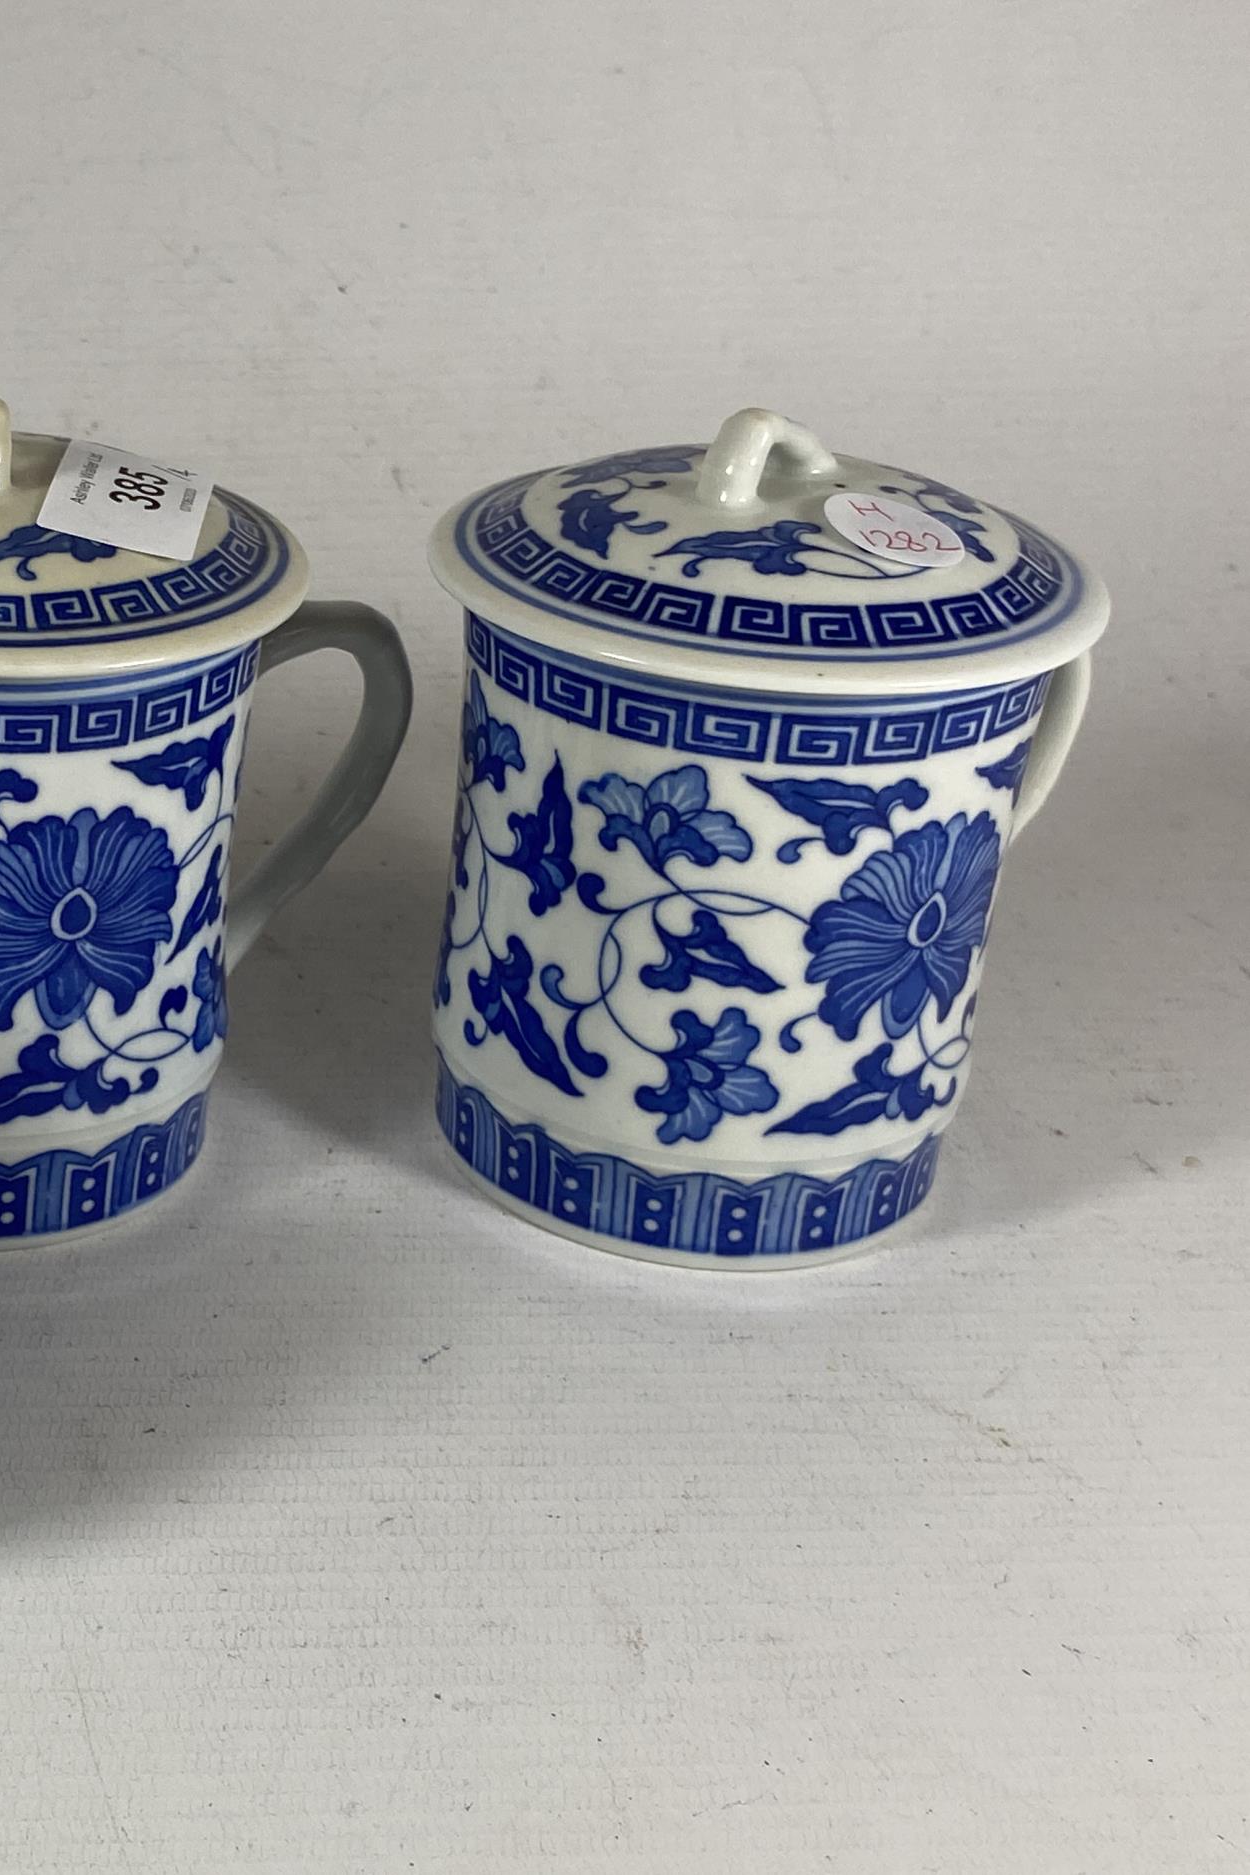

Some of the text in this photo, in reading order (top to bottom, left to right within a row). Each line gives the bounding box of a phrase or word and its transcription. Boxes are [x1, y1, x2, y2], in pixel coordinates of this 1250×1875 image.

[109, 466, 168, 511] 385
[847, 499, 894, 522] H
[858, 529, 962, 552] 1282
